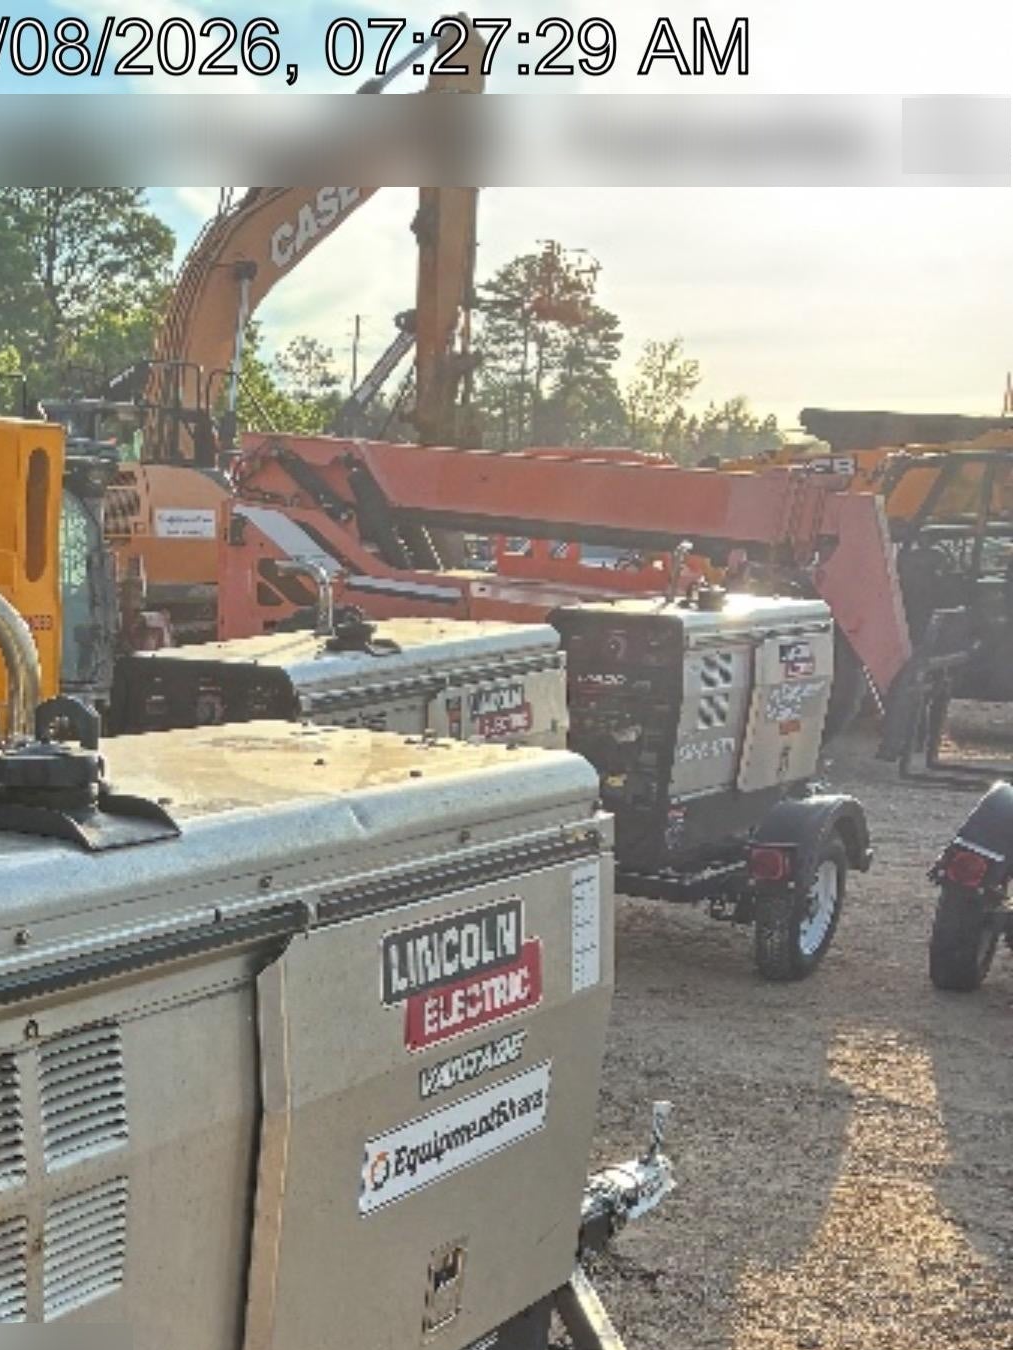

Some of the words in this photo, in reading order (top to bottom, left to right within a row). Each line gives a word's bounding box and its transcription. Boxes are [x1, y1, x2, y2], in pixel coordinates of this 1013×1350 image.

[390, 910, 518, 994] LINCOLN
[423, 966, 531, 1036] ELECTRIC
[391, 1087, 545, 1176] EquipmentShare
